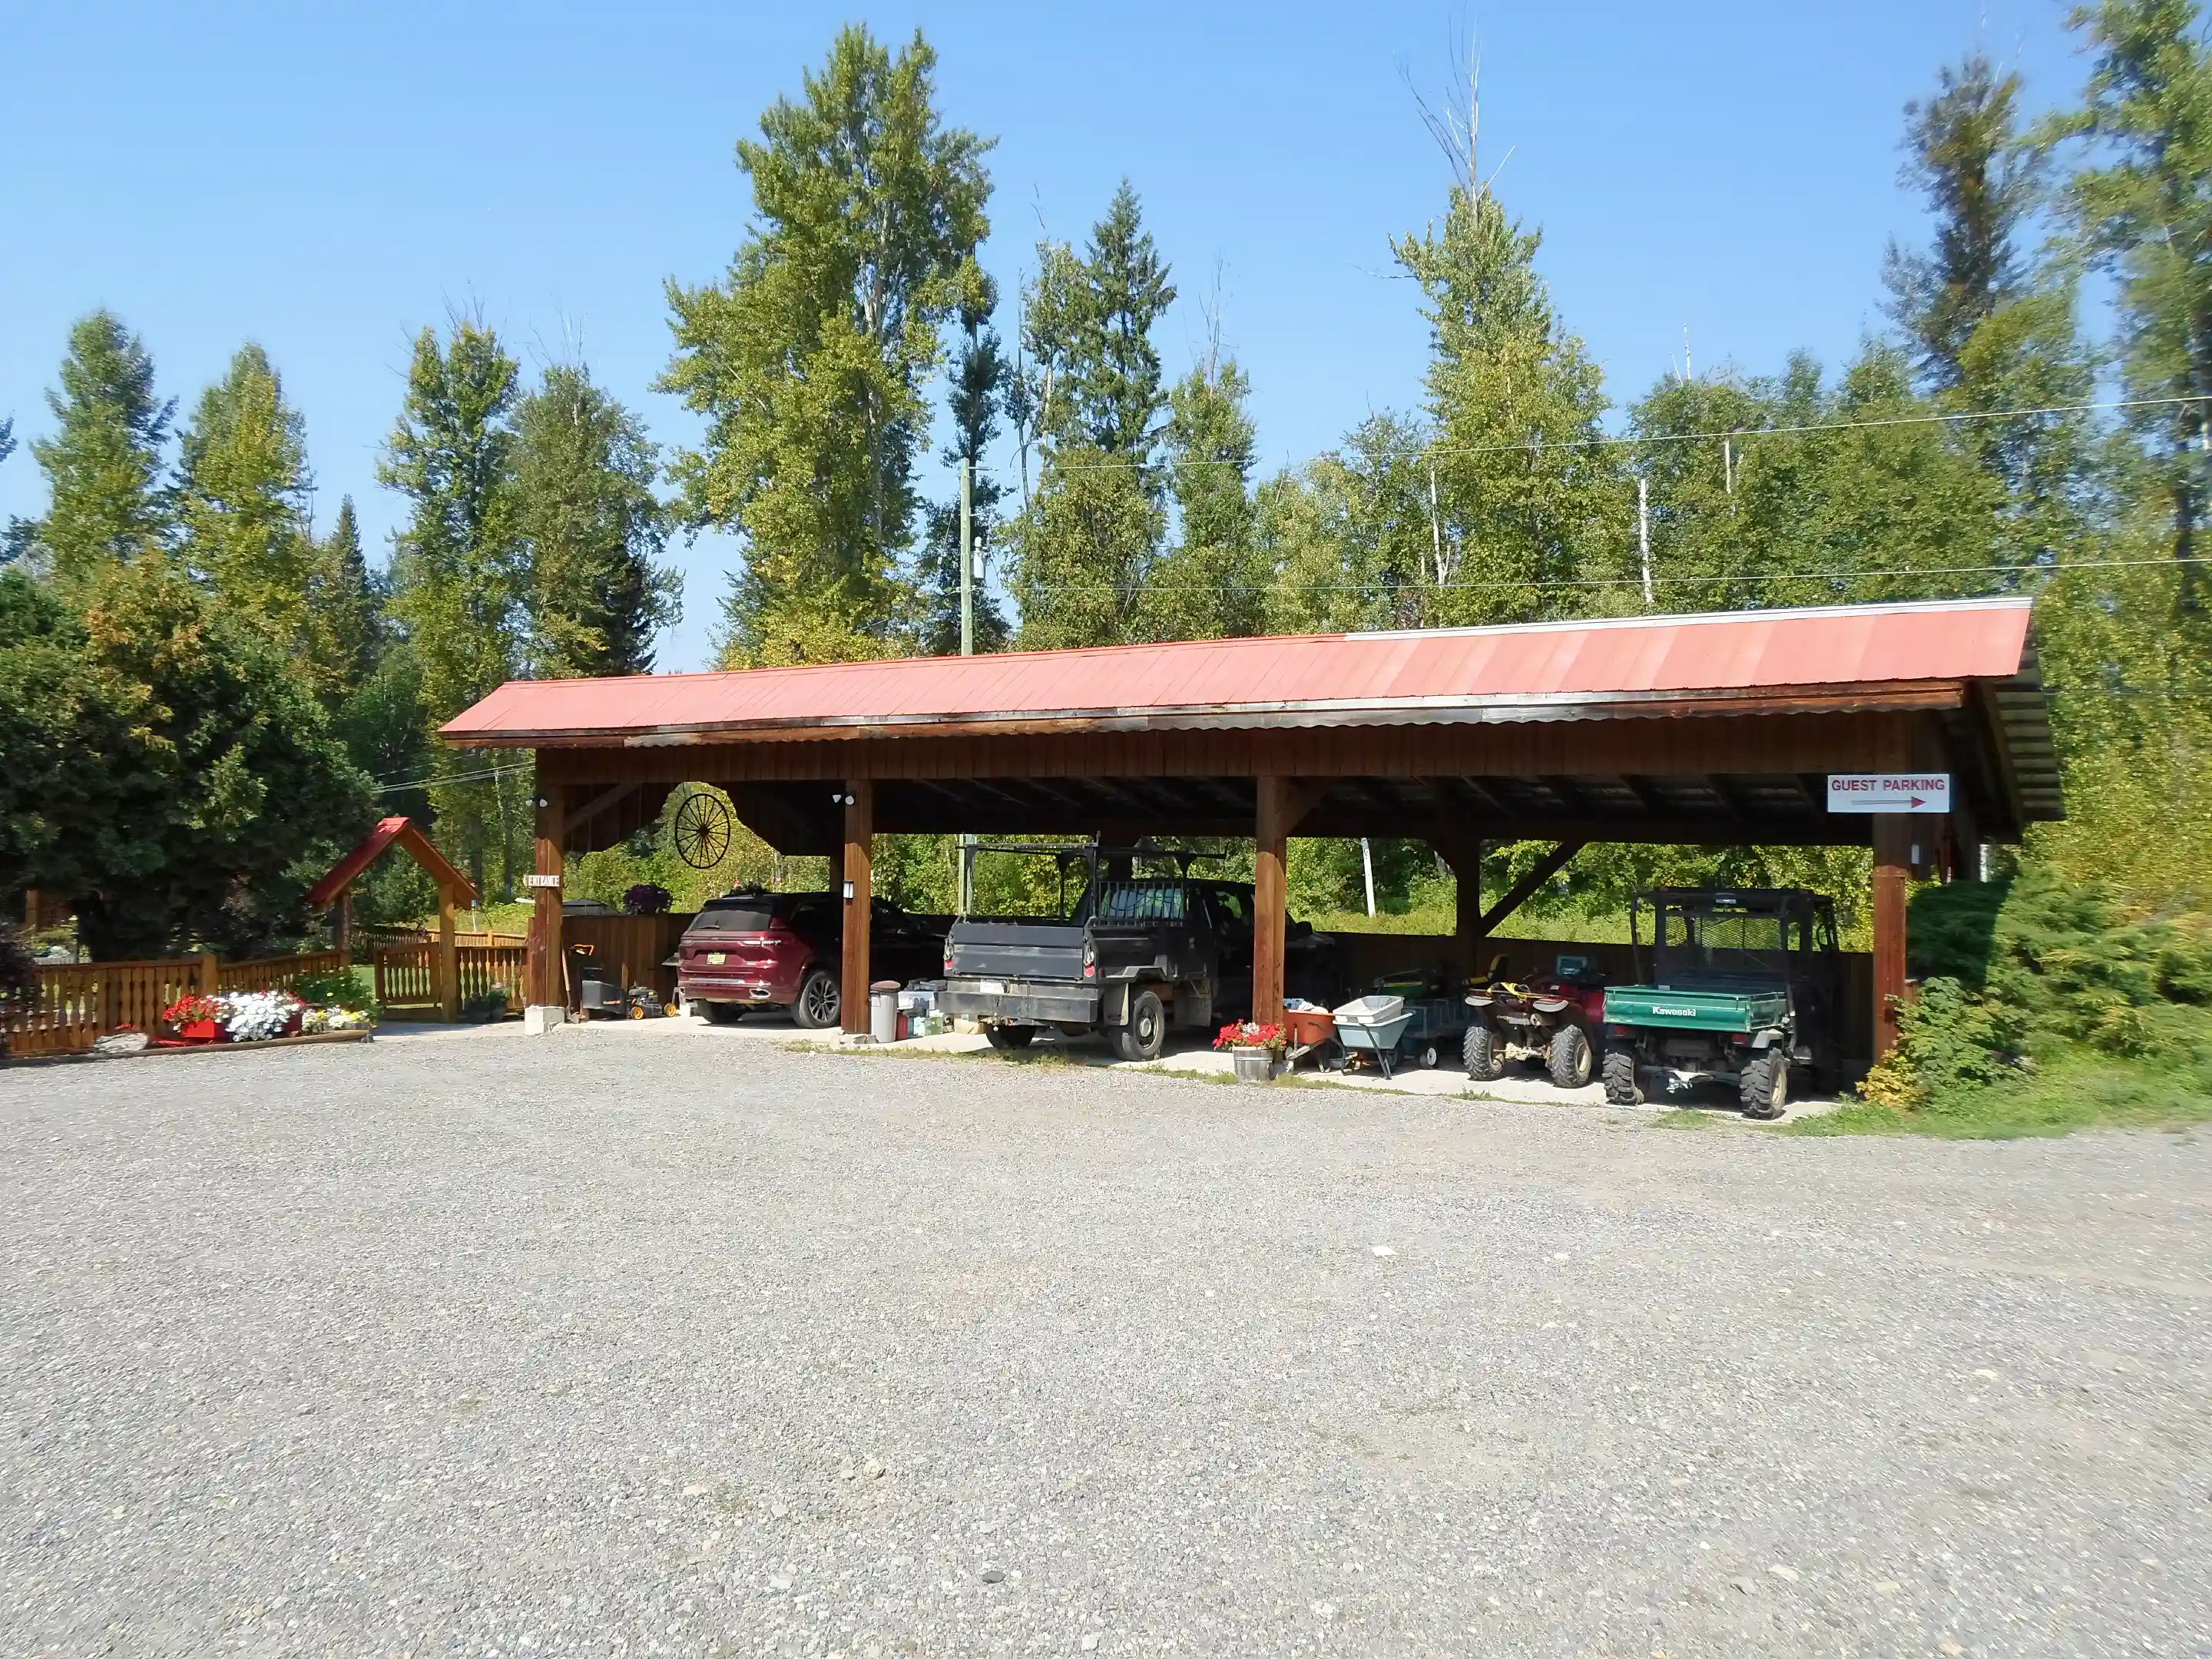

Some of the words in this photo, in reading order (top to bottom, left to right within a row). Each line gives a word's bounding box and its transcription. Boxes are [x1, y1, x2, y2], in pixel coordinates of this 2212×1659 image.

[1832, 780, 1877, 791] GUEST
[1883, 779, 1945, 790] PARKING
[1652, 1006, 1697, 1017] Kawasaki
